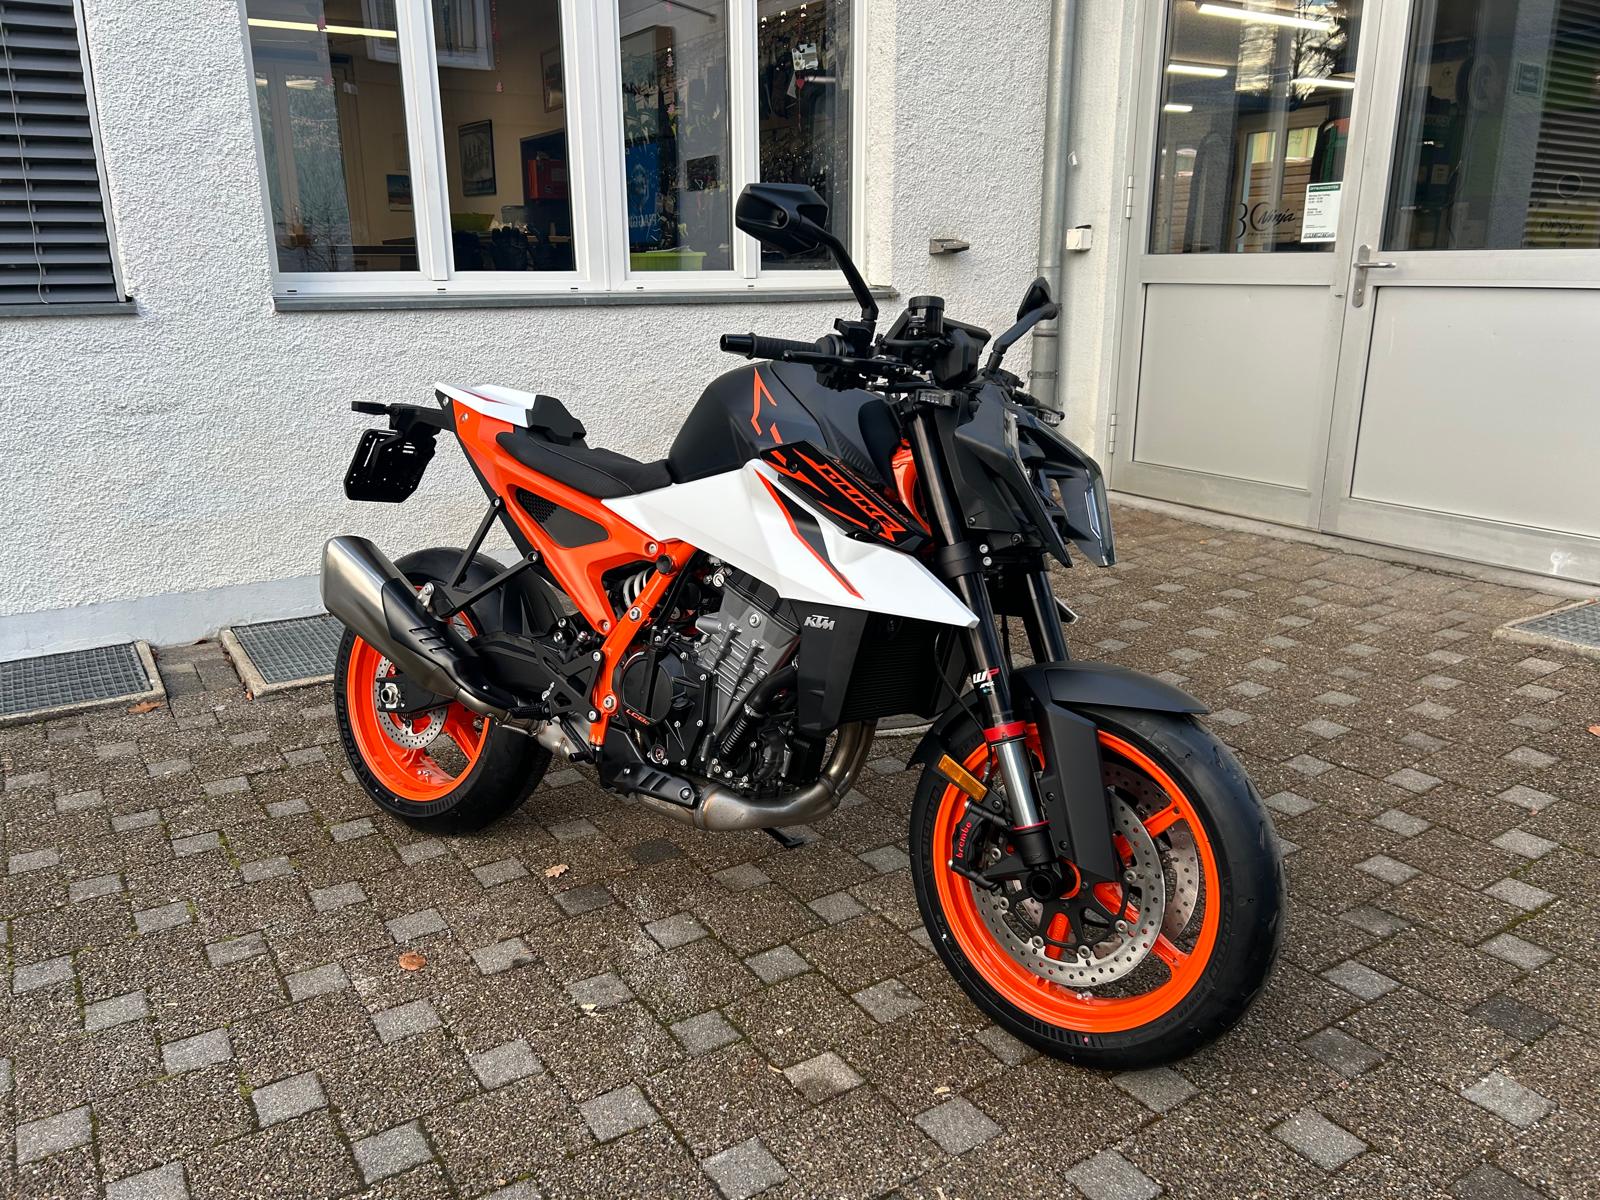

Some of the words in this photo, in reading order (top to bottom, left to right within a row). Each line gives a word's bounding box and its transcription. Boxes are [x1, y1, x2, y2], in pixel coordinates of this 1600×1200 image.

[1257, 208, 1296, 227] Ninja
[803, 614, 836, 630] KTM
[973, 668, 1000, 684] WP
[955, 821, 972, 860] brembo
